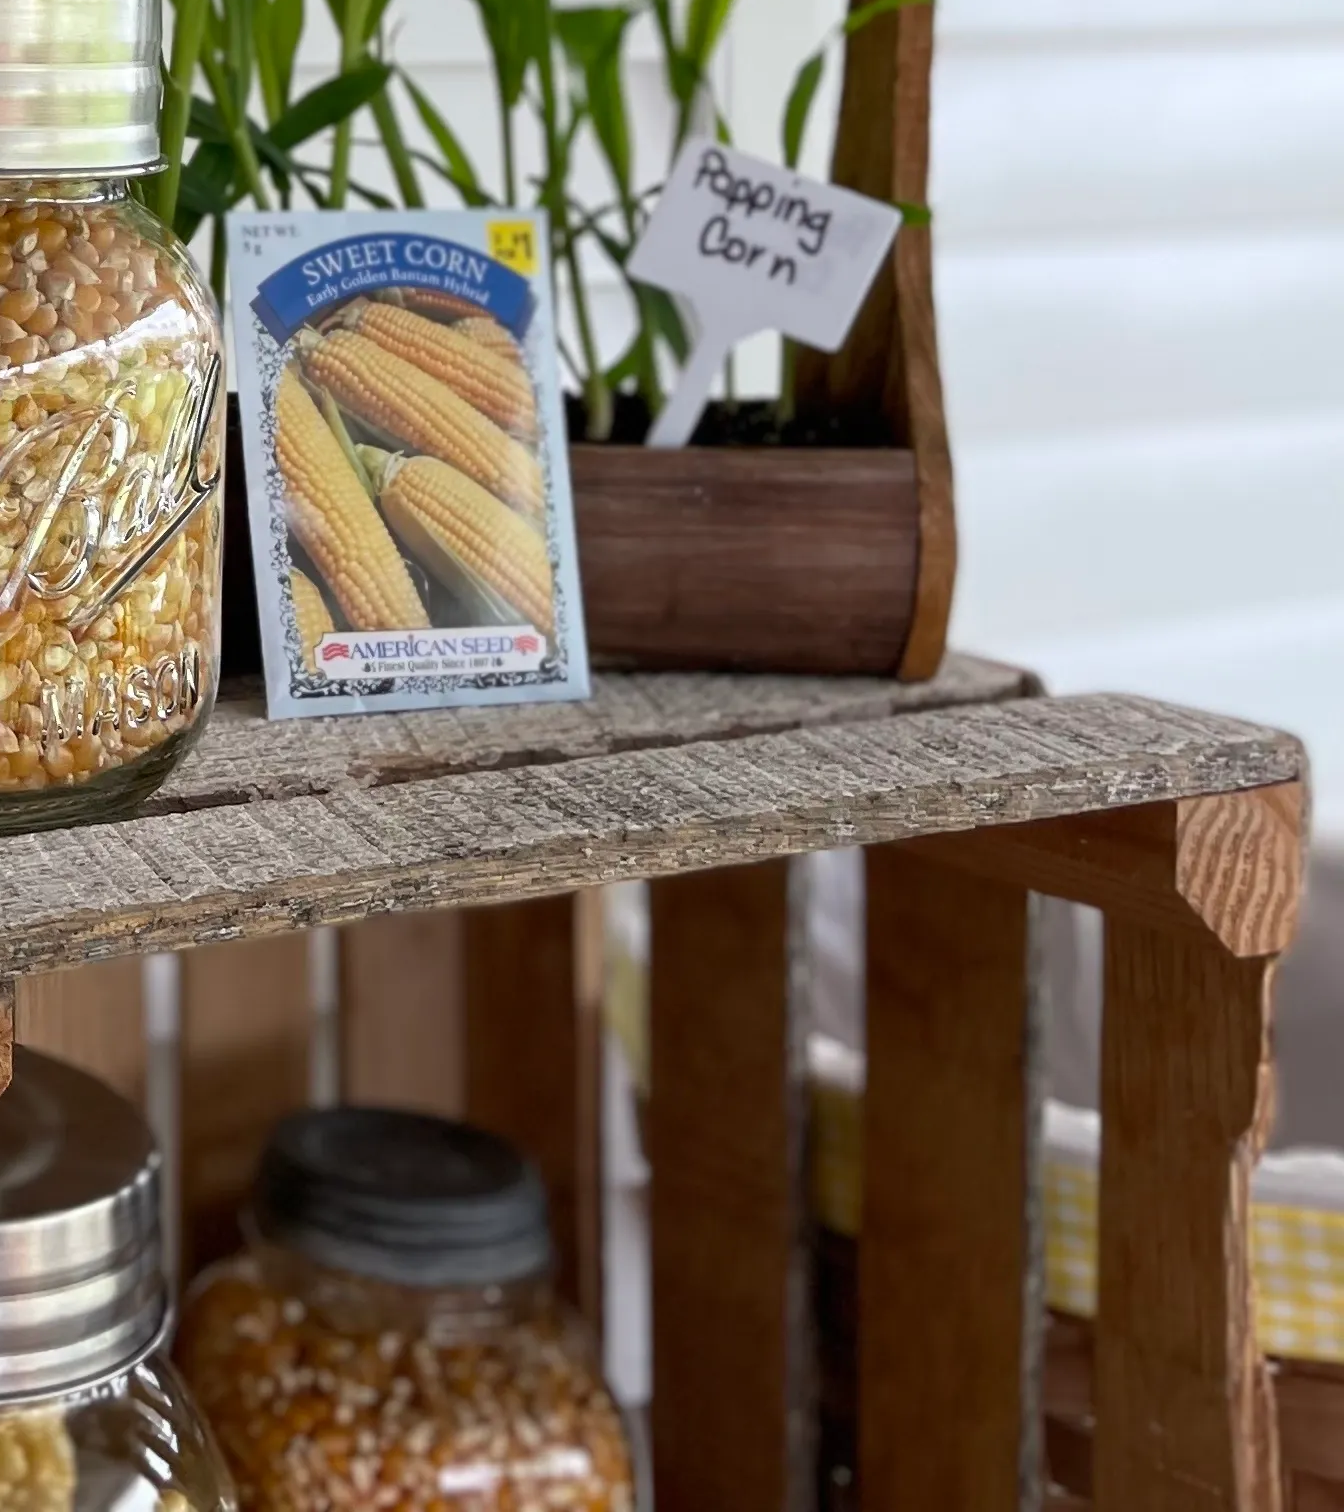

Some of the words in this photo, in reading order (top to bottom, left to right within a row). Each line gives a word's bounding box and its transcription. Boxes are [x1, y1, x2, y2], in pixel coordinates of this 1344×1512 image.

[693, 147, 832, 256] Popping
[242, 225, 271, 237] NET
[699, 215, 797, 285] Corn
[303, 239, 397, 286] SWEET
[404, 240, 488, 284] CORN
[306, 283, 338, 307] Early
[340, 268, 387, 291] Golden
[391, 267, 440, 285] Bantam
[443, 275, 490, 306] Hybrid
[350, 634, 458, 659] AMERICAN
[462, 637, 514, 655] SEED
[378, 661, 405, 673] Finest
[408, 659, 438, 673] Quality
[442, 658, 465, 669] Since
[41, 646, 200, 743] MASON
